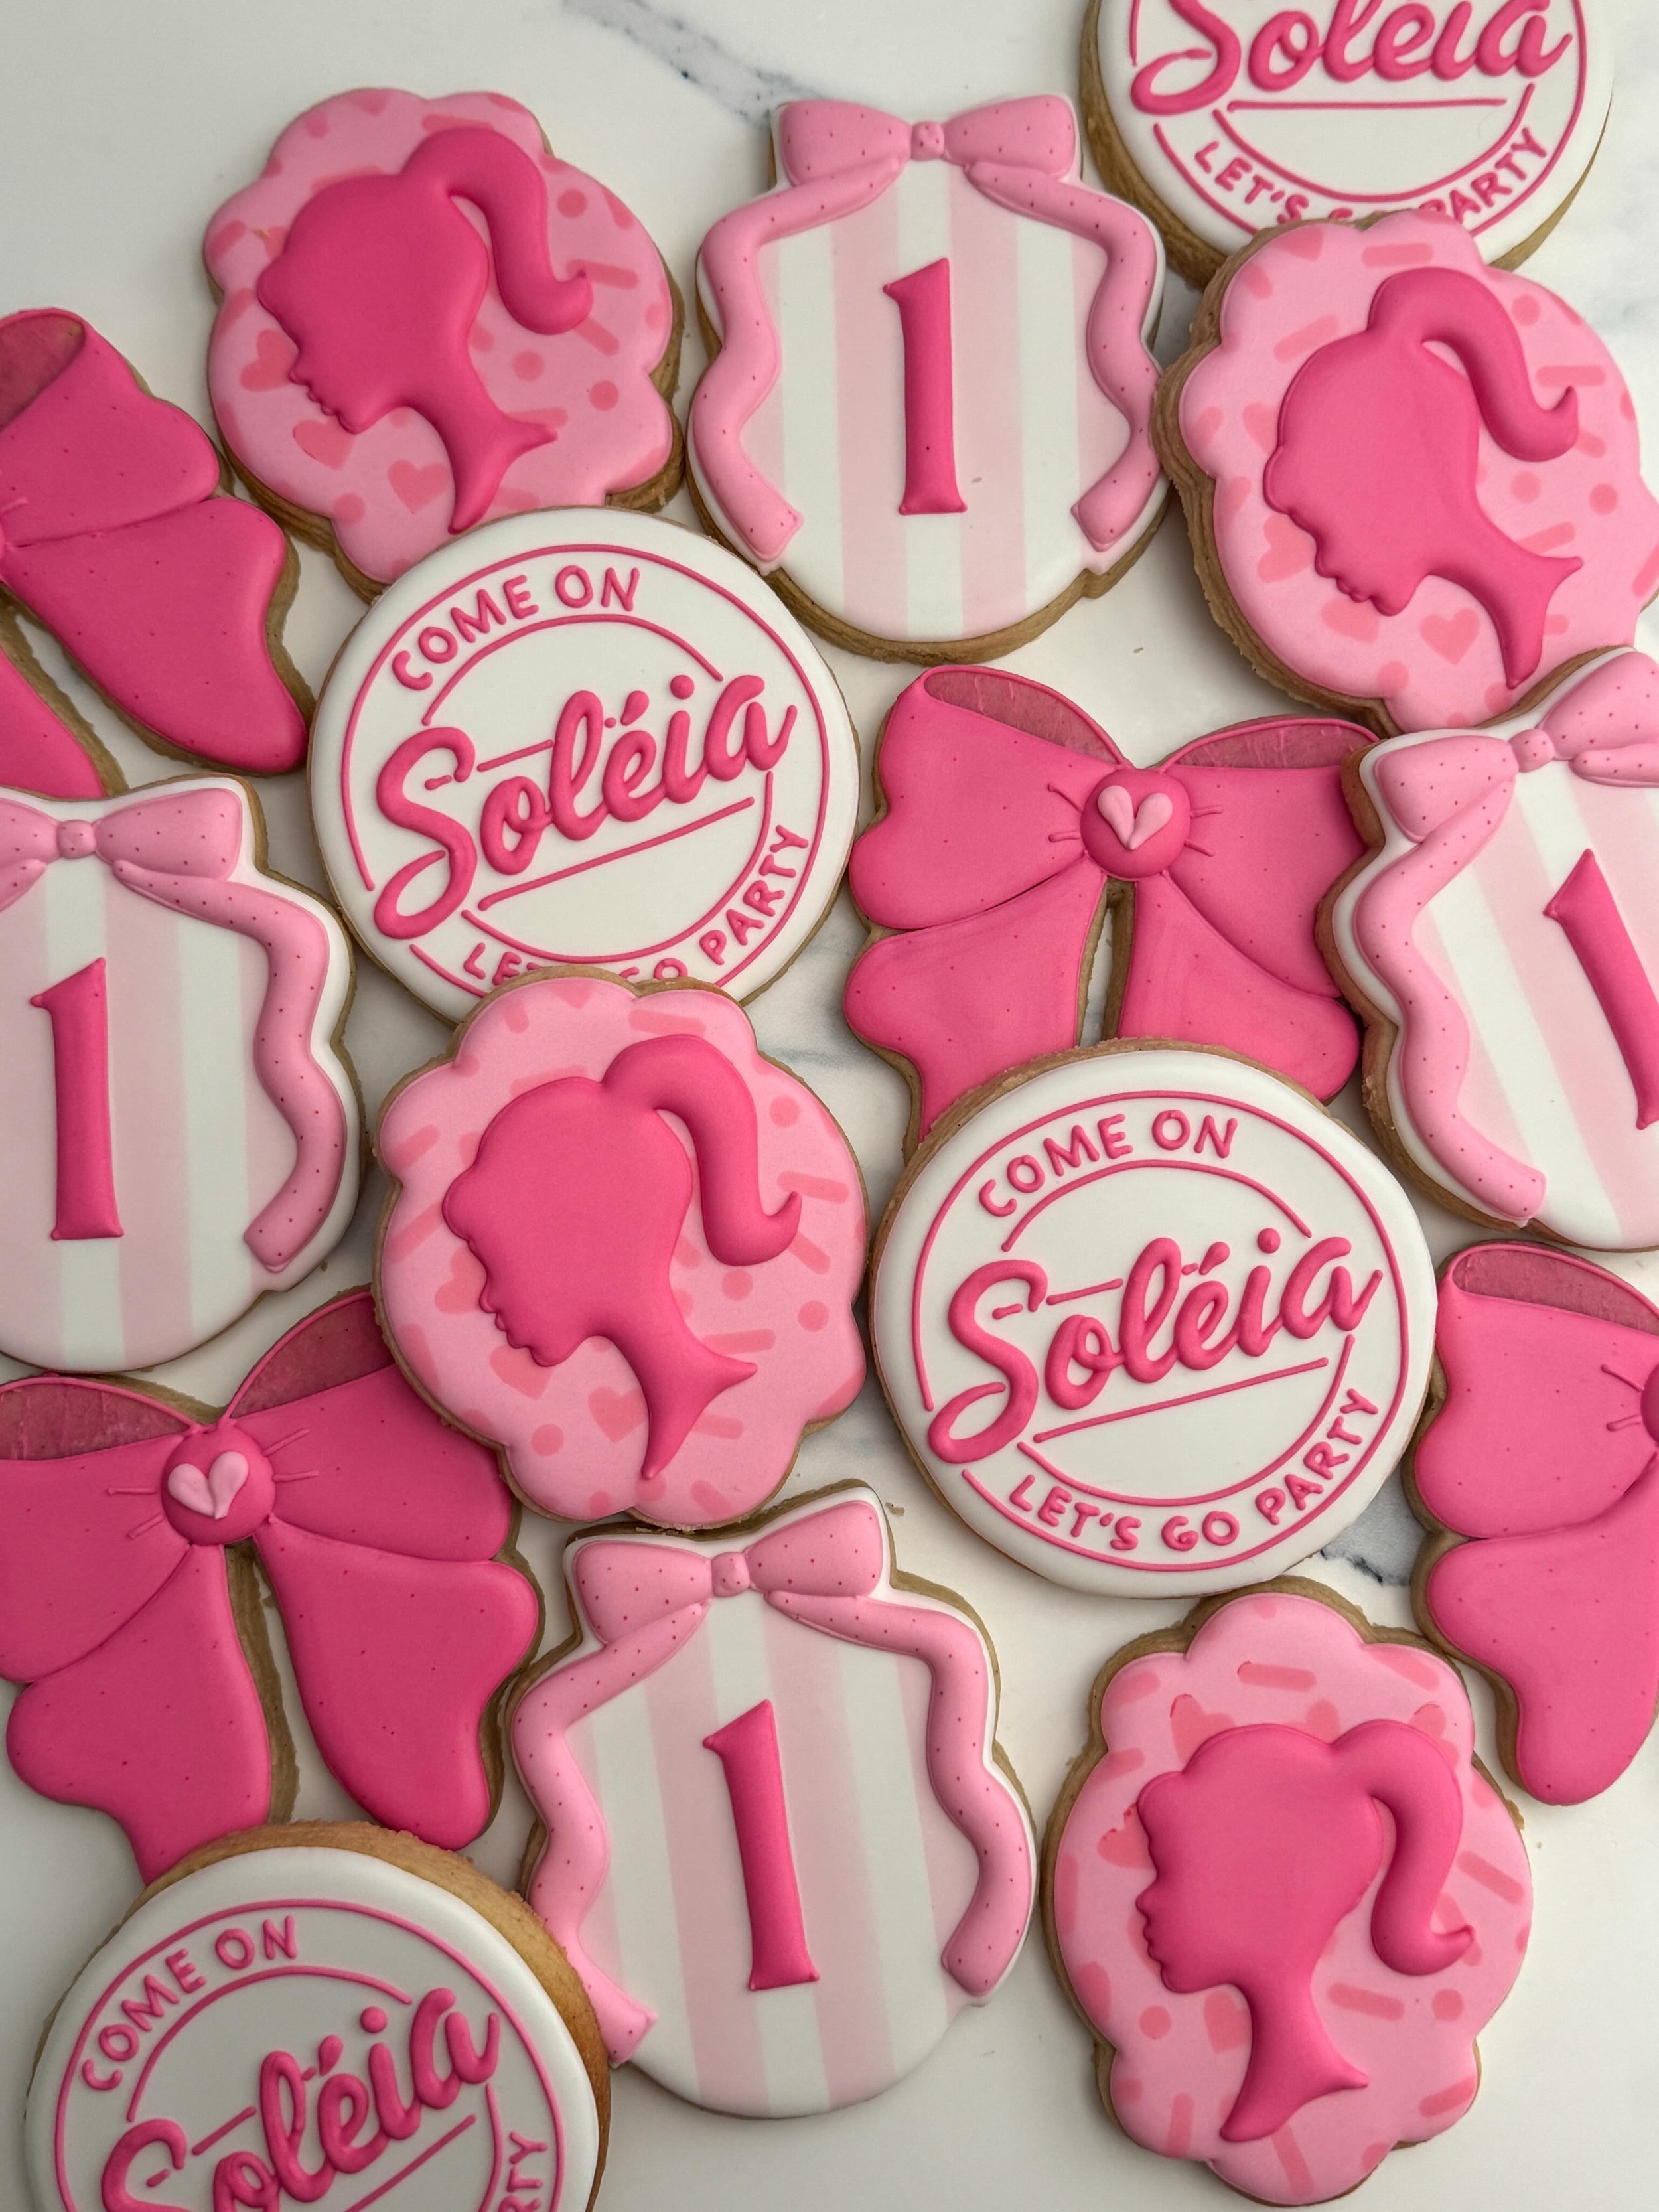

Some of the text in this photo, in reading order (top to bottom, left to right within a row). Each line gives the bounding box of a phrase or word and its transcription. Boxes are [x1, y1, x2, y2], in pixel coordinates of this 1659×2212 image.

[1194, 141, 1309, 224] LET'S
[883, 257, 968, 516] 1
[391, 564, 640, 691] COME ON
[373, 674, 799, 940] Soléia
[699, 825, 810, 966] PARTY
[1543, 849, 1659, 1130] 1
[29, 957, 125, 1241] 1
[978, 1109, 1238, 1218] COME ON
[928, 1228, 1384, 1465] Soléia
[1008, 1388, 1379, 1552] LET'S GO PARTY
[701, 1699, 820, 1992] 1
[82, 1916, 297, 2091] COME ON
